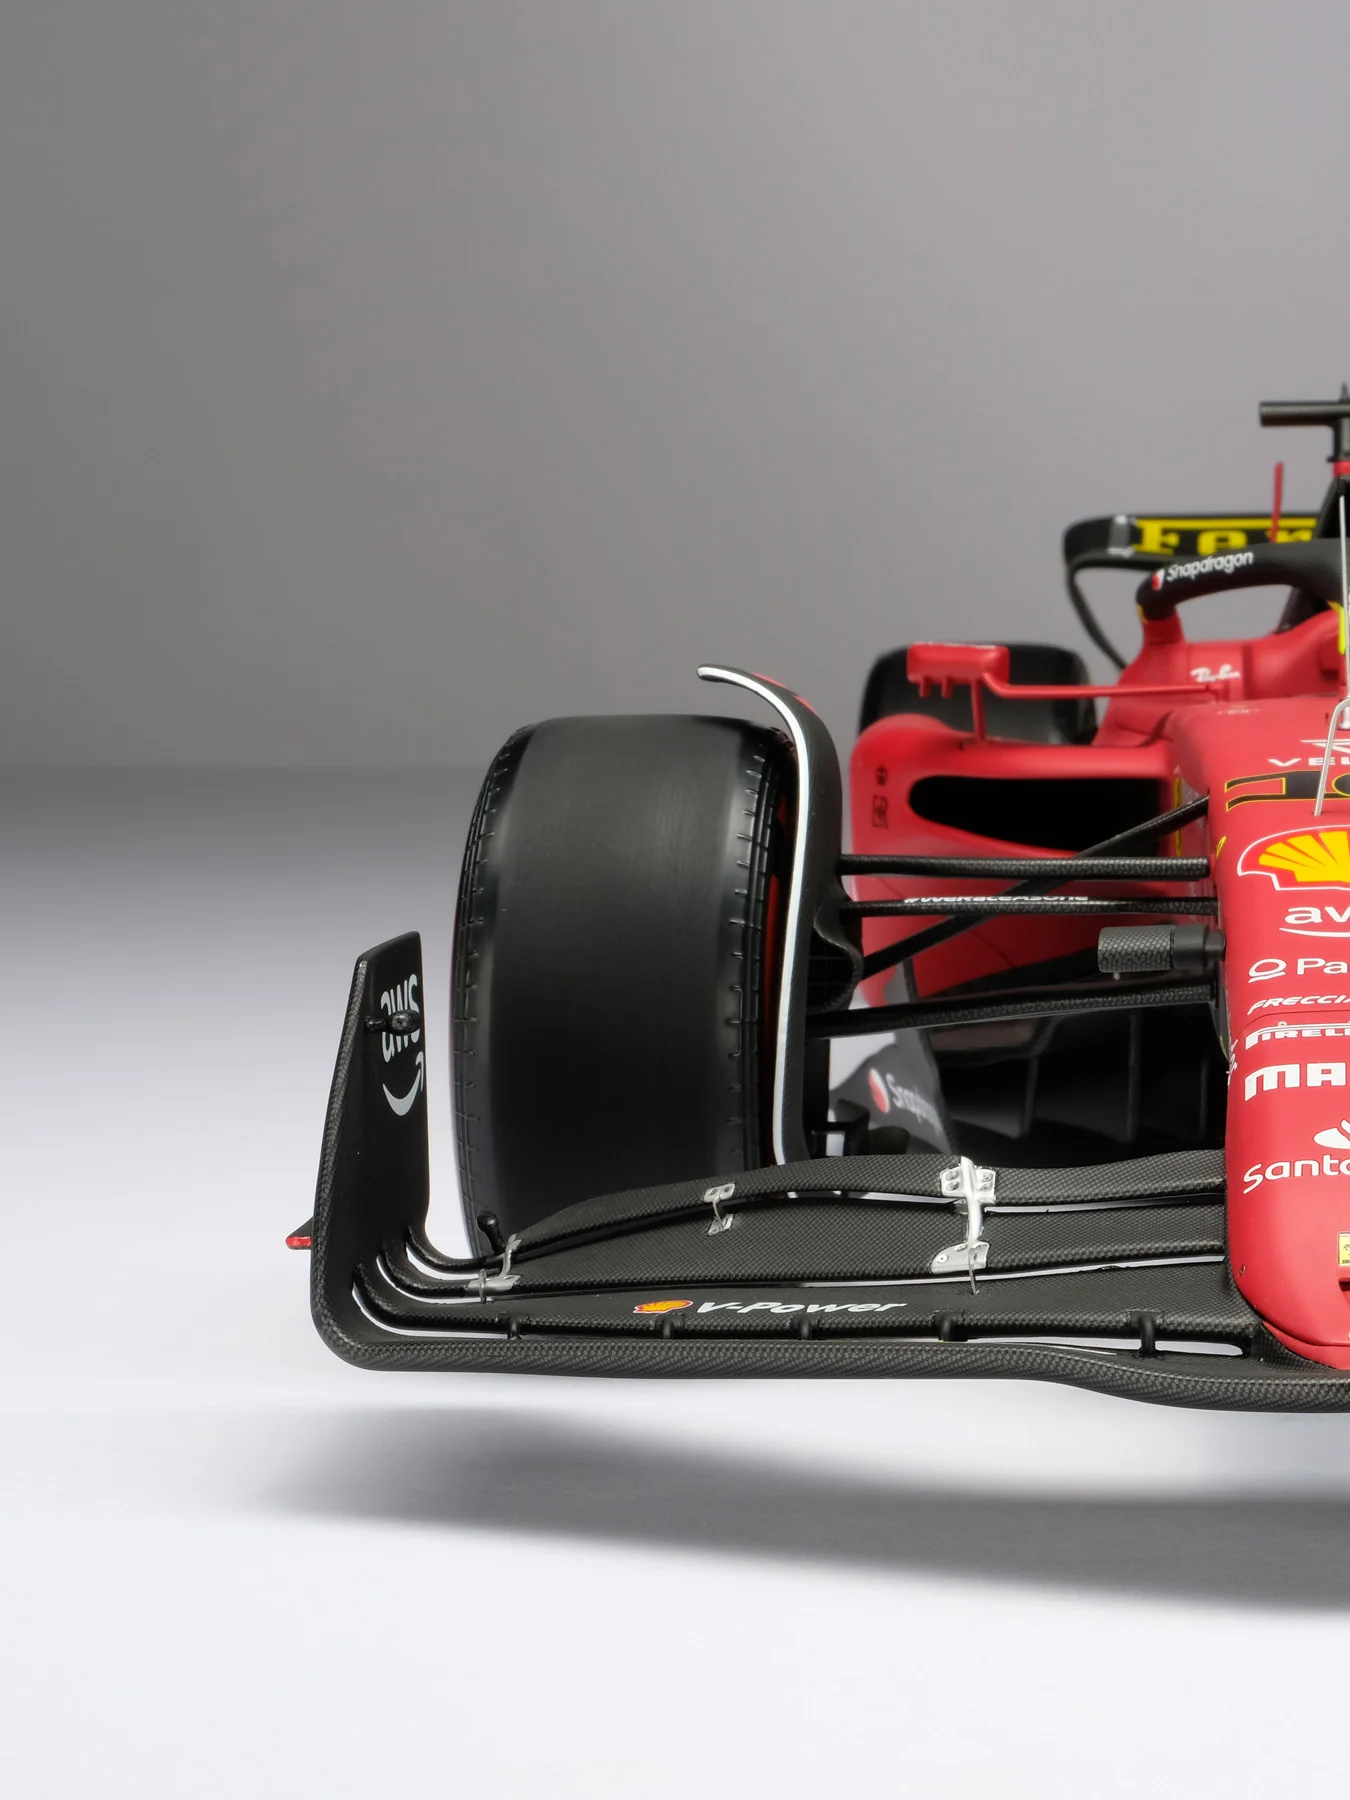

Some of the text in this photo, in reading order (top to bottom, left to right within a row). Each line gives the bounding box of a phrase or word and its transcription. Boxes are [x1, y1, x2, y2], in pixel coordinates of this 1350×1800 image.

[1166, 551, 1255, 582] Snapdragon
[380, 973, 421, 1063] aws
[696, 1301, 909, 1314] V-Power
